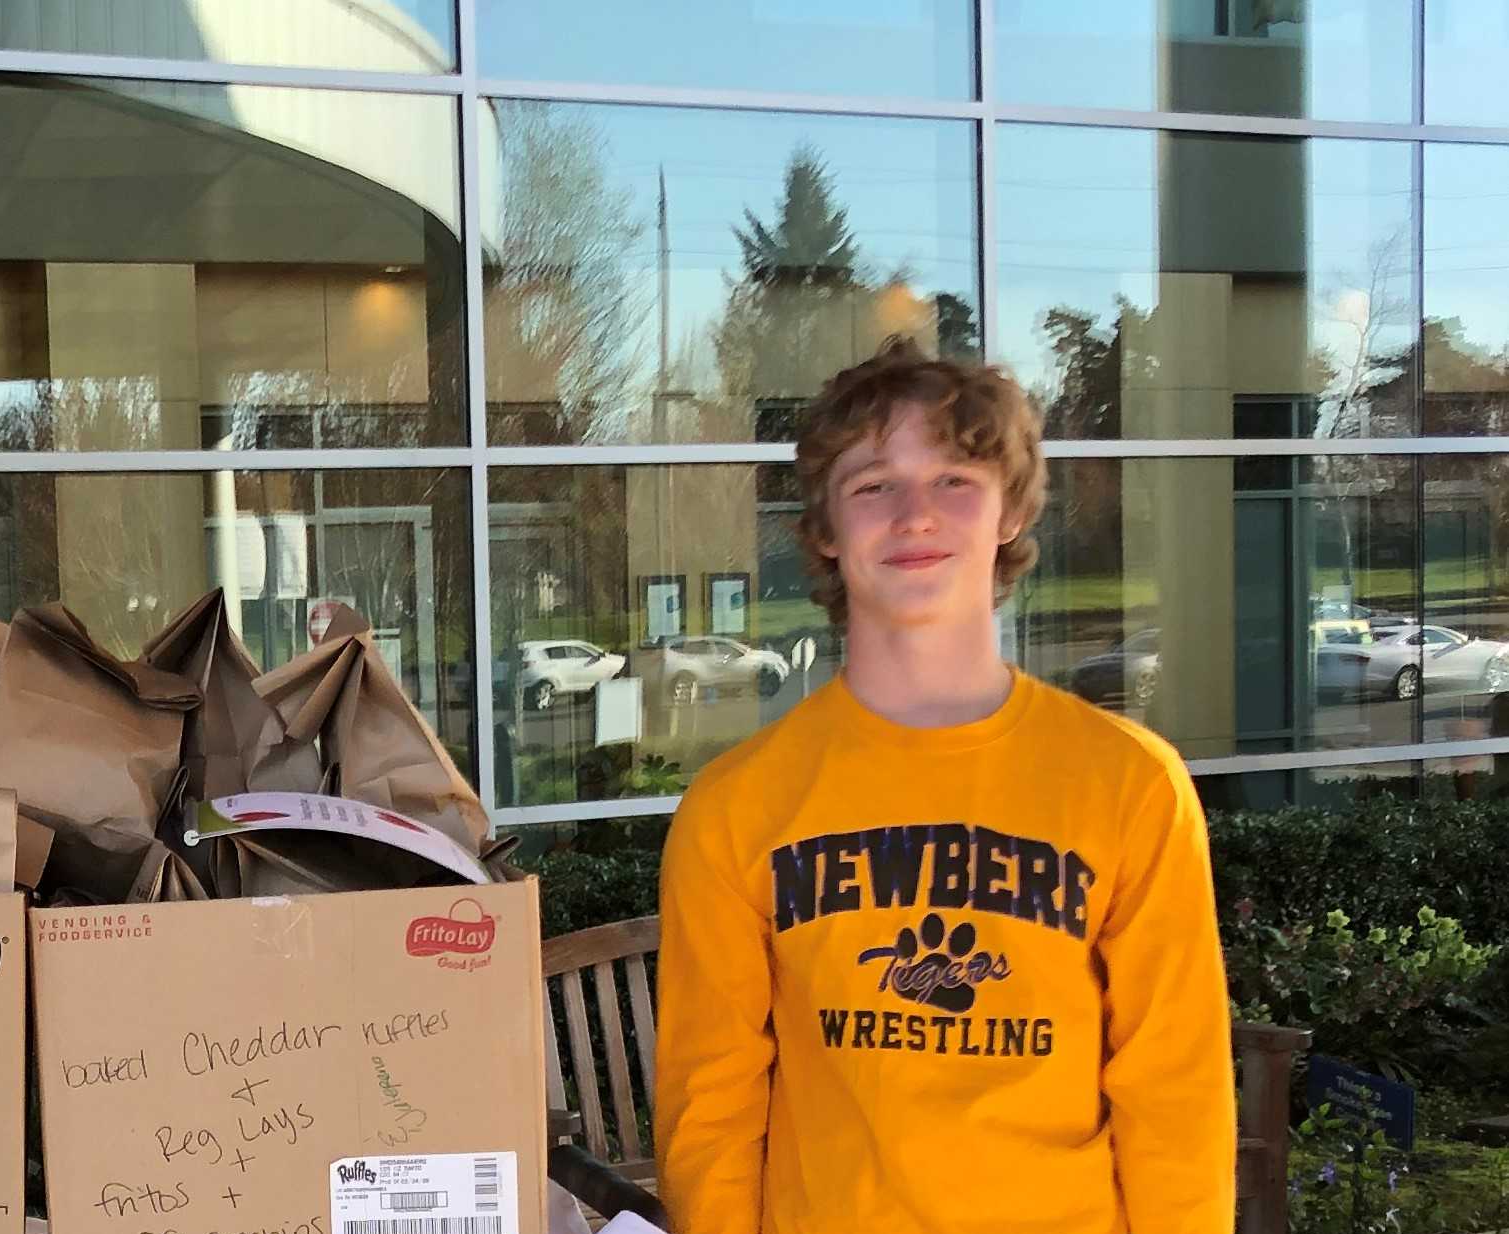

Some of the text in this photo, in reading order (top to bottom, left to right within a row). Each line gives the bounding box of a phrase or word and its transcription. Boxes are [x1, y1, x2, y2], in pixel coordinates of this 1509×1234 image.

[38, 915, 127, 930] VENDING
[38, 927, 153, 943] FOODSERVICE
[437, 957, 467, 970] Good
[857, 946, 1013, 1004] Tigers
[182, 1020, 342, 1077] Cheddar
[819, 1009, 1053, 1056] WRESTLING
[154, 1125, 224, 1165] Reg
[336, 1160, 377, 1185] Ruffles
[93, 1181, 190, 1217] fritos
